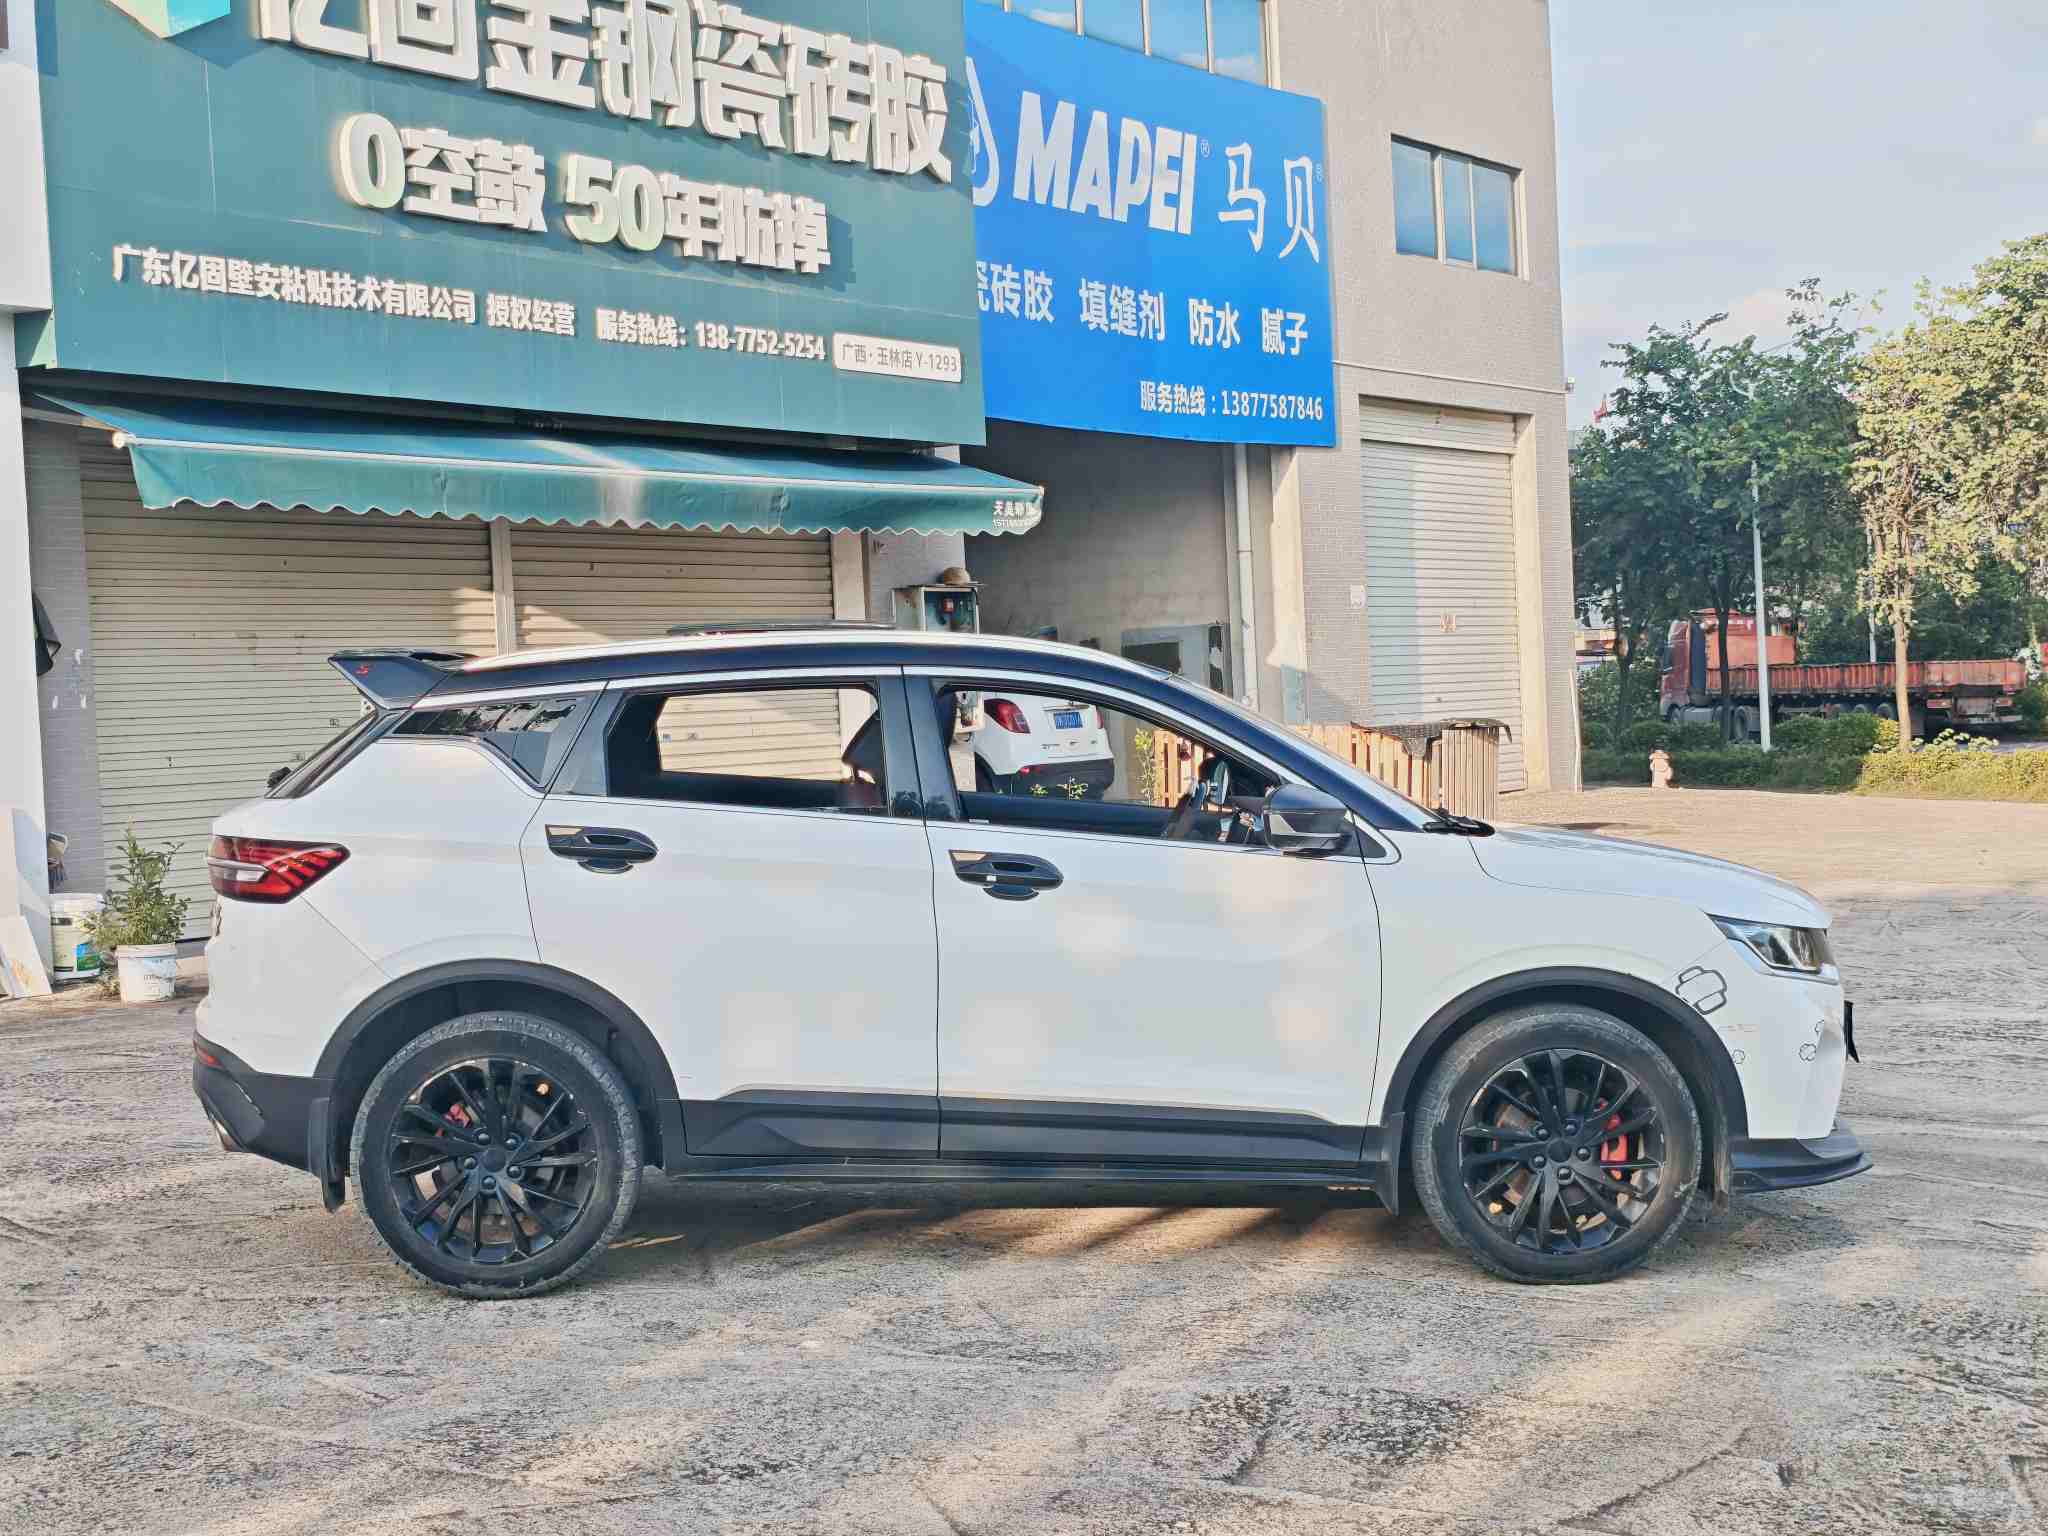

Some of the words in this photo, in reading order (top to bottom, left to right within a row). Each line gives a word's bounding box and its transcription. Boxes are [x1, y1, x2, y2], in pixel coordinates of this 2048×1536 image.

[340, 113, 548, 233] 0空鼓
[1013, 90, 1197, 235] MAPEI
[1217, 142, 1320, 264] 马贝
[486, 292, 576, 337] 授权经营
[1078, 277, 1166, 342] 填缝剂
[1187, 297, 1241, 350] 防水
[1260, 306, 1309, 357] 腻子
